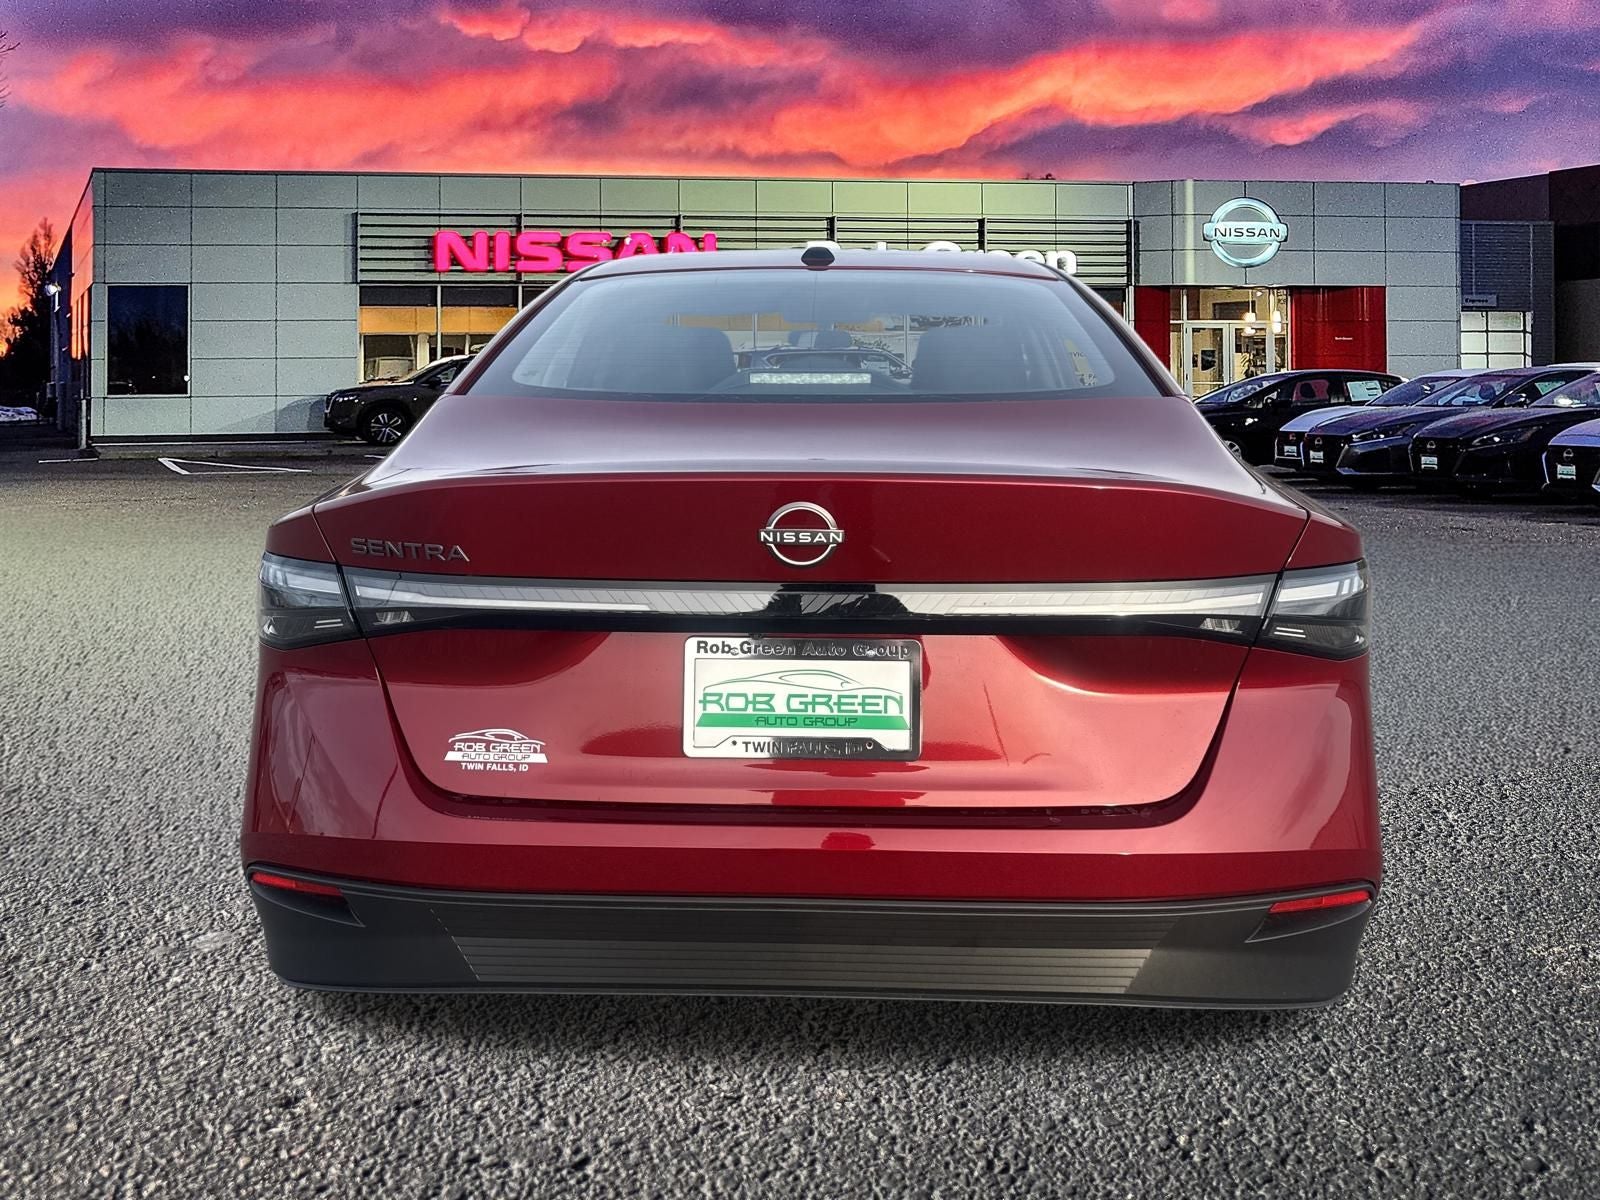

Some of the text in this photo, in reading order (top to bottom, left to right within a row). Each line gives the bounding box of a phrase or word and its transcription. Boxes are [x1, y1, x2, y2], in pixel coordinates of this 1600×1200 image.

[1214, 227, 1280, 238] NISSAN
[760, 531, 843, 543] NISSAN
[350, 537, 470, 562] SENTRA
[696, 640, 731, 655] Rob
[739, 641, 796, 656] Green
[802, 642, 846, 656] Auto
[699, 692, 903, 714] ROB GREEN
[754, 716, 858, 727] AUTO GROUP
[453, 742, 541, 753] ROB GREEN
[742, 741, 783, 754] TWIN
[493, 753, 531, 762] GROUP
[460, 763, 529, 773] TWIN FALLS, ID
